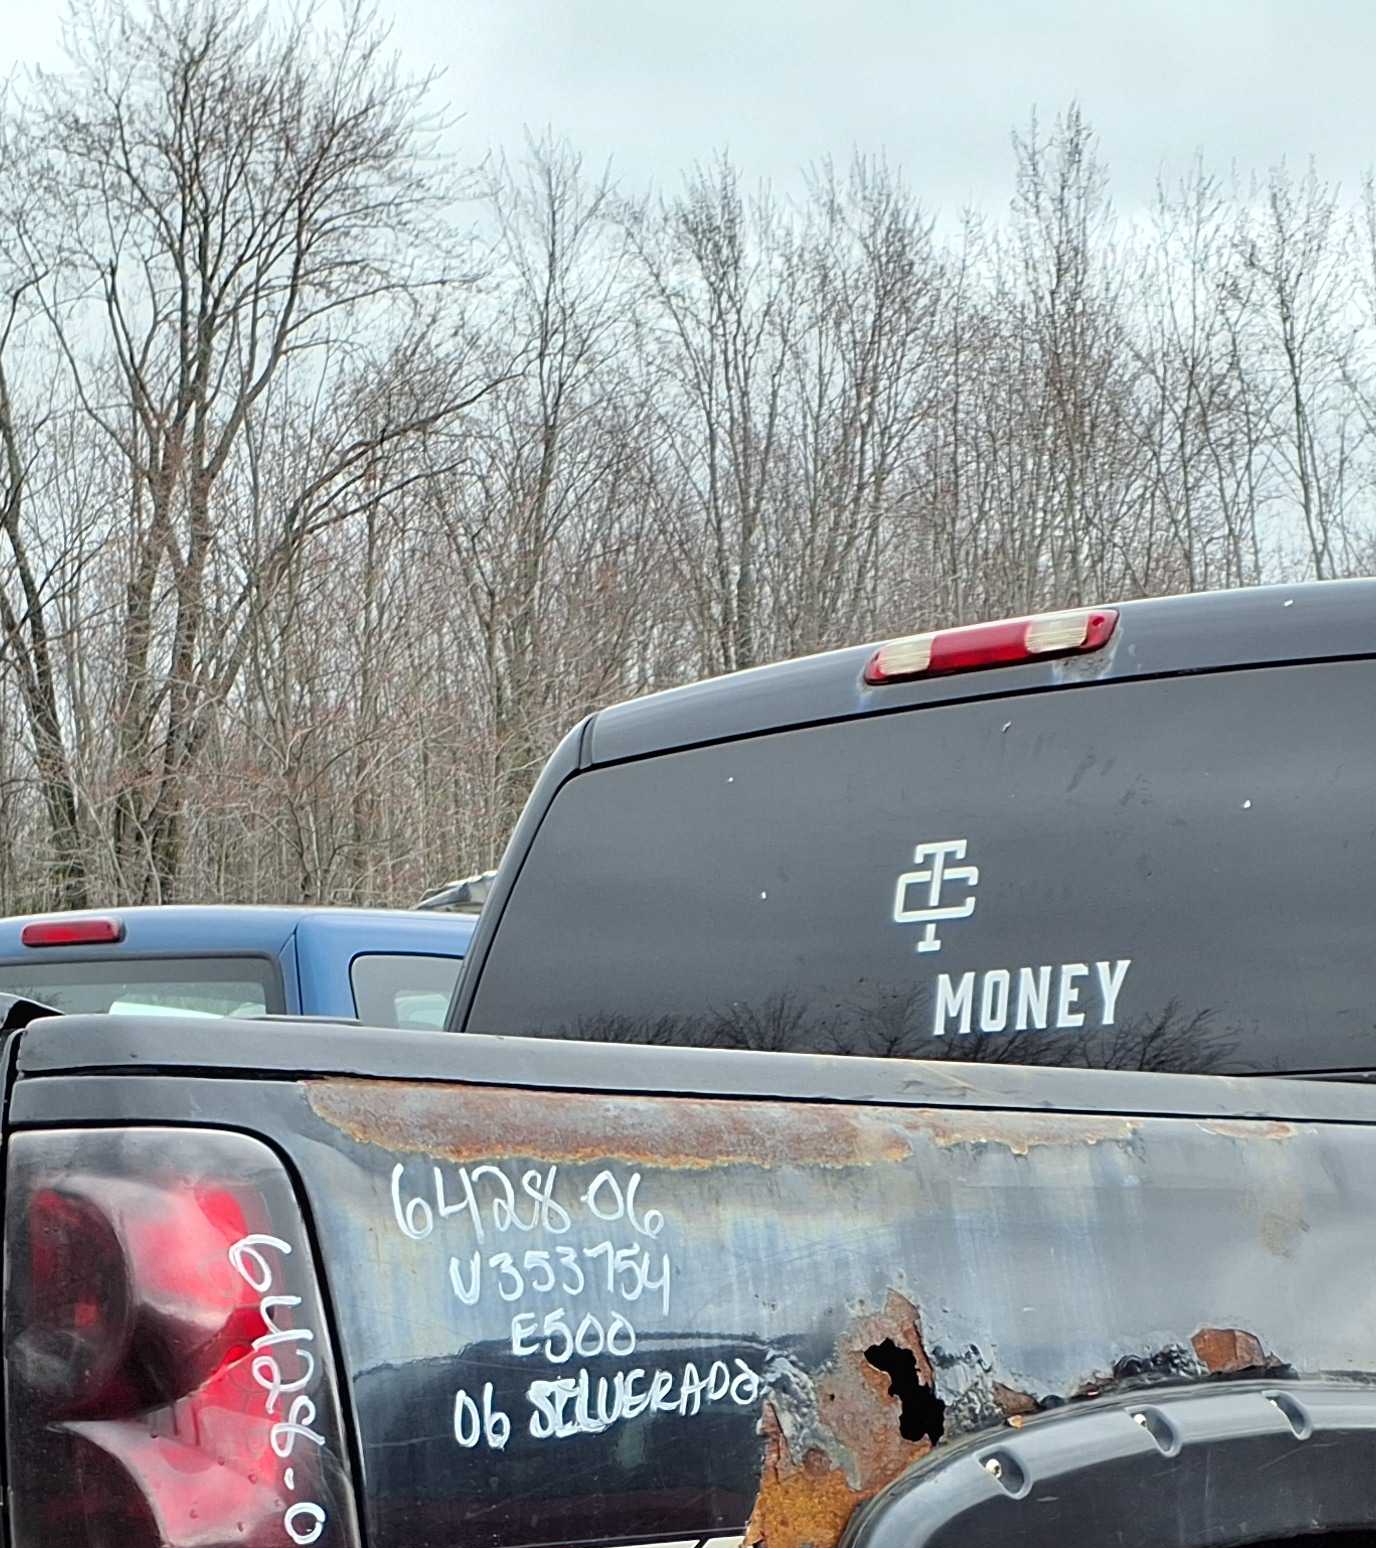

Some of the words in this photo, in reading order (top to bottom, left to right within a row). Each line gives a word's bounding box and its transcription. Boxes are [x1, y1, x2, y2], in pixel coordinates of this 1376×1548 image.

[932, 959, 1132, 1036] MONEY
[511, 1307, 637, 1364] E500
[453, 1382, 511, 1451] 06
